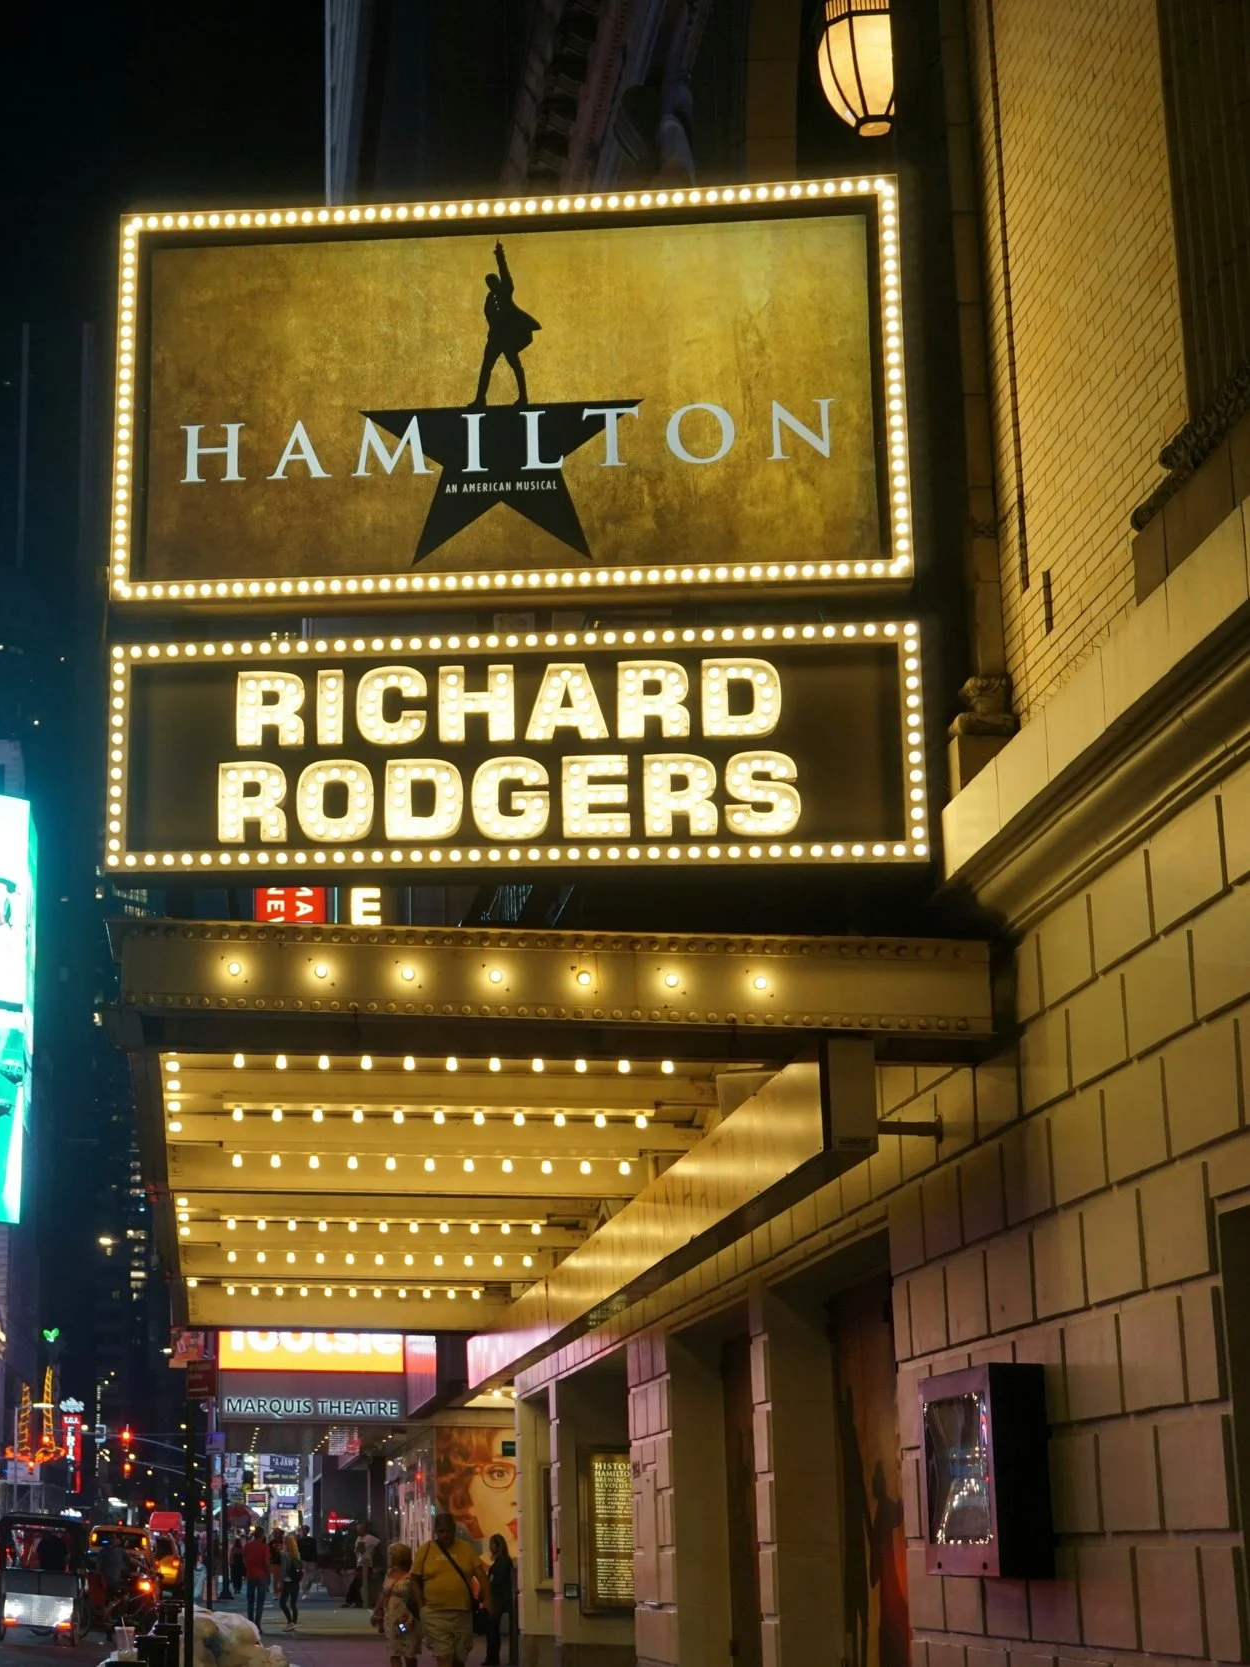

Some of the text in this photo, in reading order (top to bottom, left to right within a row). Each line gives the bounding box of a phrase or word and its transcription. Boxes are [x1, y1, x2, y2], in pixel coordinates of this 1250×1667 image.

[180, 398, 835, 483] HAMILTON
[445, 479, 557, 494] AN AMERICAN MUSICAL
[236, 657, 781, 746] RICHARD
[217, 751, 801, 843] RODGERS
[227, 1398, 399, 1417] MARQUIS THEATRE
